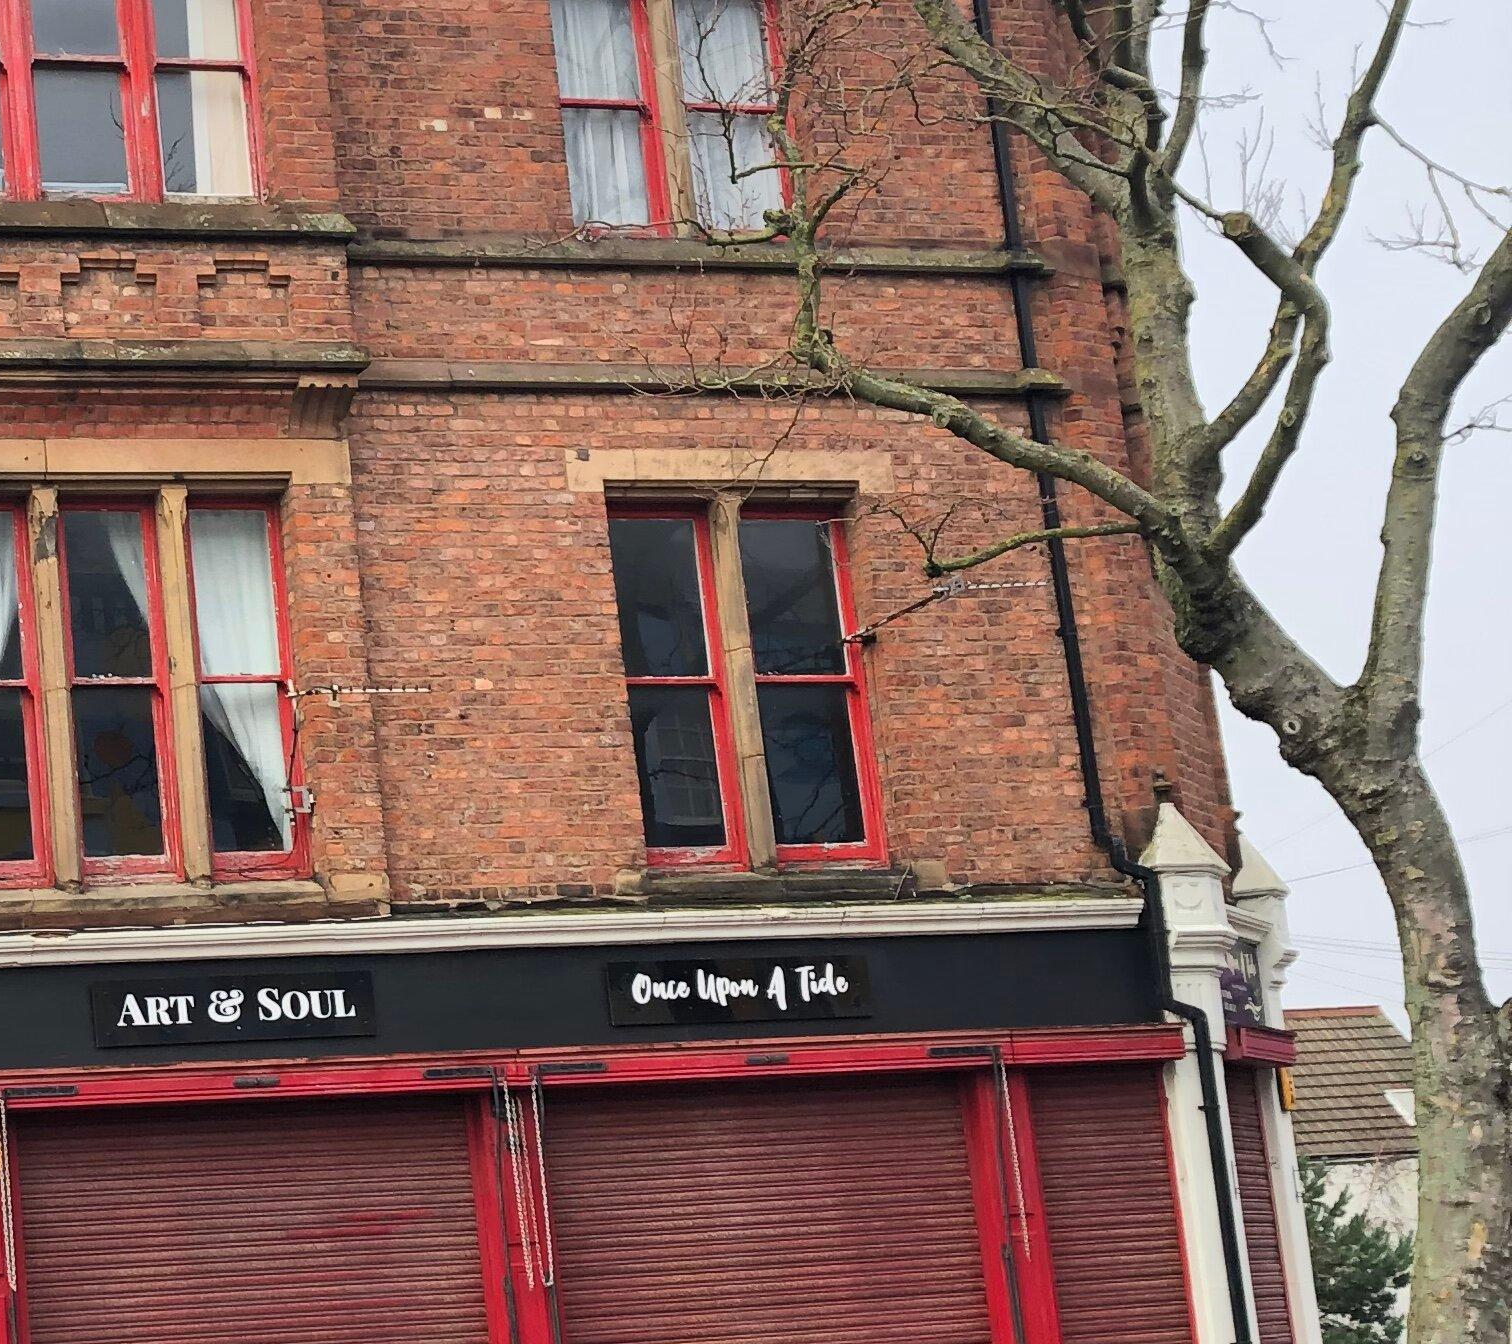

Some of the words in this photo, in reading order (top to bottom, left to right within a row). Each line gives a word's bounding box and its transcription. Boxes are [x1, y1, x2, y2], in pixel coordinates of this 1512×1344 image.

[116, 993, 195, 1027] ART
[207, 989, 245, 1023] &
[257, 987, 357, 1021] SOUL
[631, 972, 691, 1005] Once
[697, 968, 759, 1007] Upon
[766, 965, 788, 1011] A
[794, 962, 849, 1002] Tide
